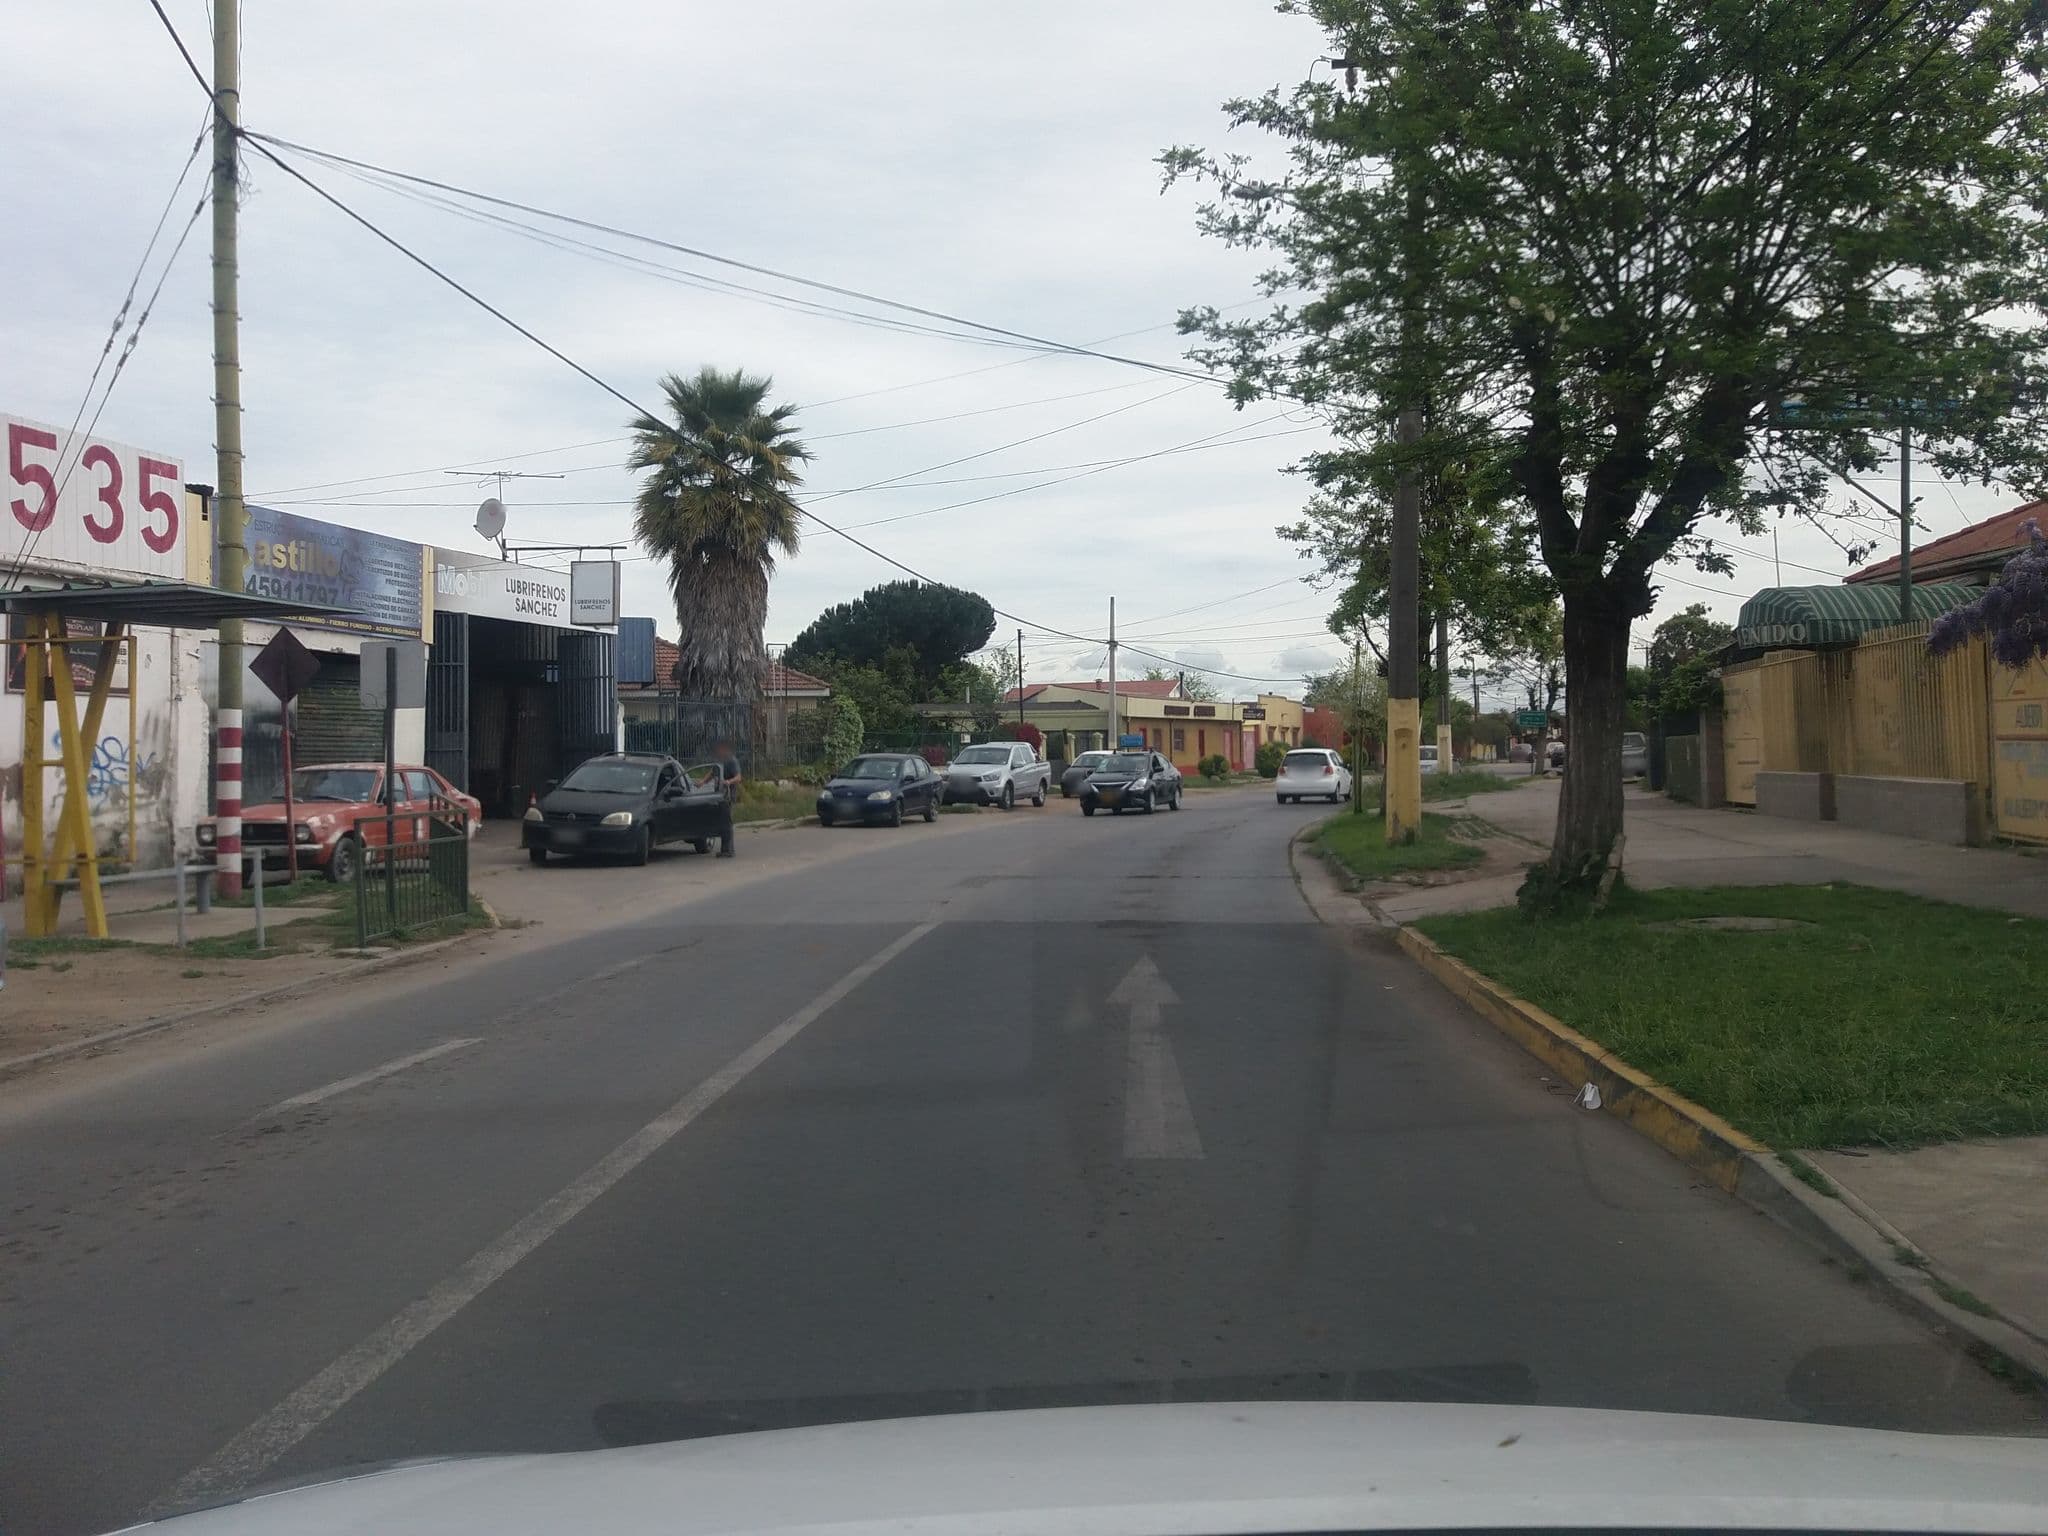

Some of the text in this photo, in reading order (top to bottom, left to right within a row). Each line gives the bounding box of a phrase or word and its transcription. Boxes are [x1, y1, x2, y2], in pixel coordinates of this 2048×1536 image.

[9, 423, 178, 553] 535
[505, 578, 566, 602] LUBRIFRENOS
[515, 597, 558, 618] SANCHEZ
